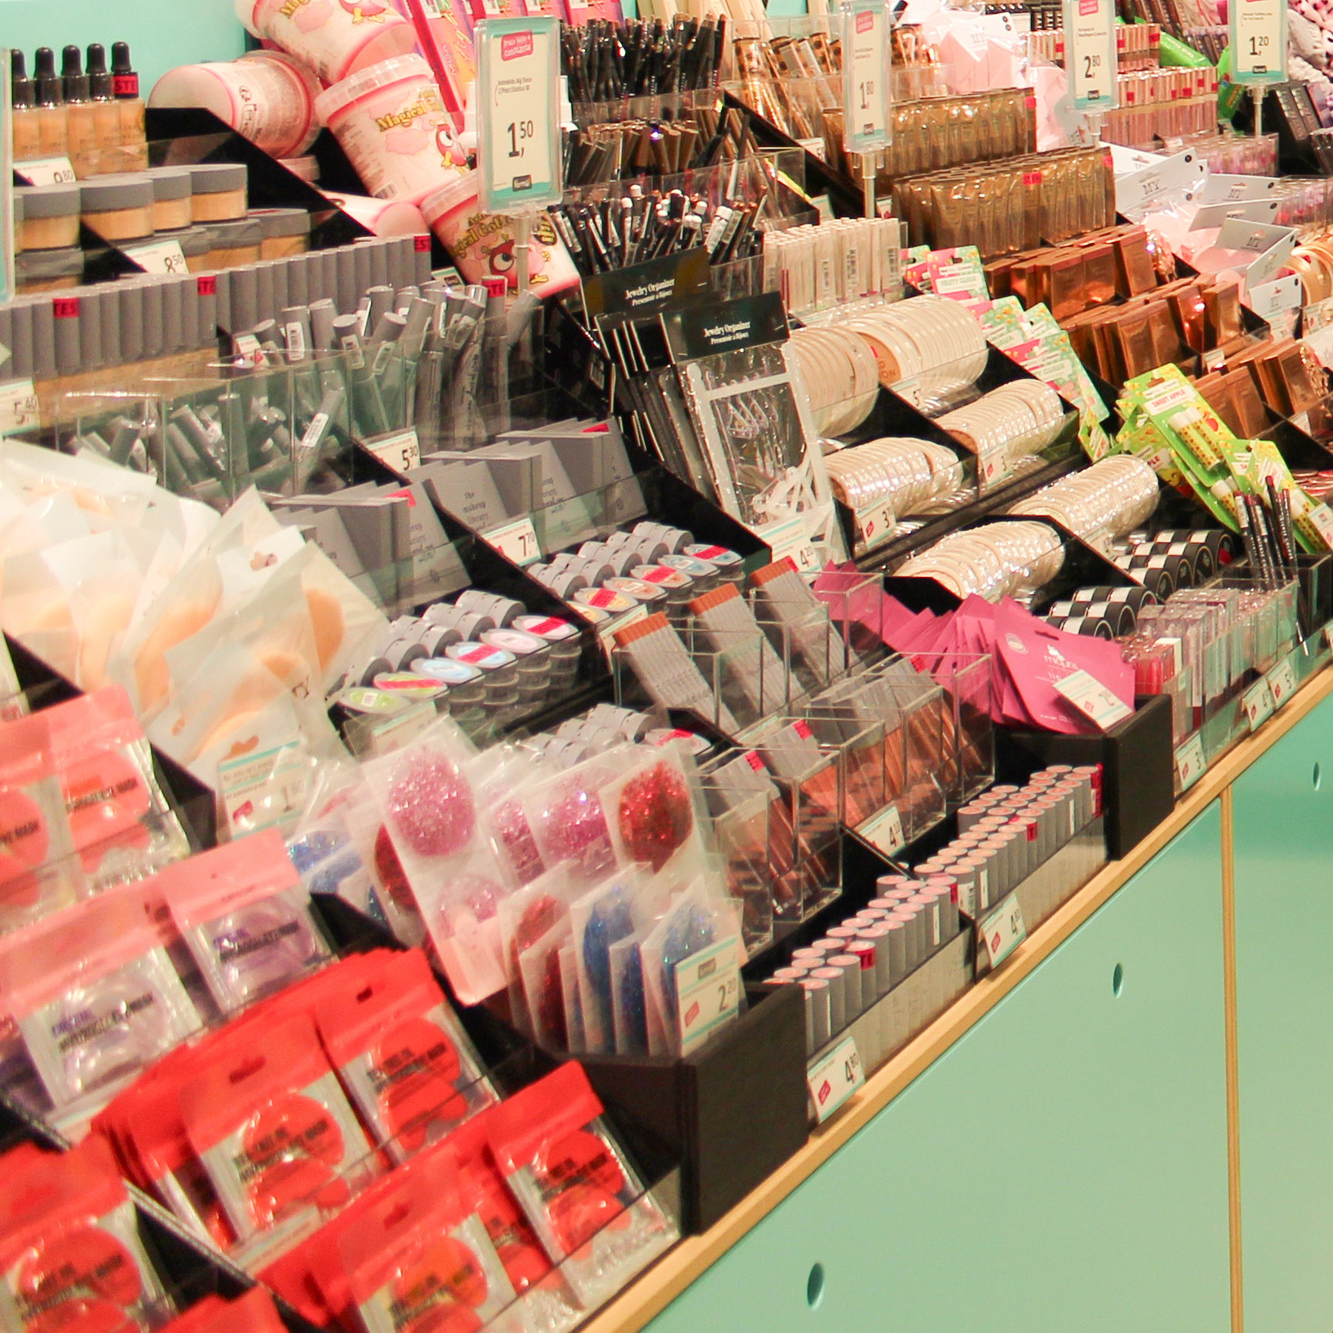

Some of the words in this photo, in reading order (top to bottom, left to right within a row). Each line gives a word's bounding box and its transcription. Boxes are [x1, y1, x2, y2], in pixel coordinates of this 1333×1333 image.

[624, 284, 647, 300] Jewelry
[646, 277, 675, 294] Organizer
[703, 324, 724, 340] Jewelry
[725, 320, 752, 336] Organizer
